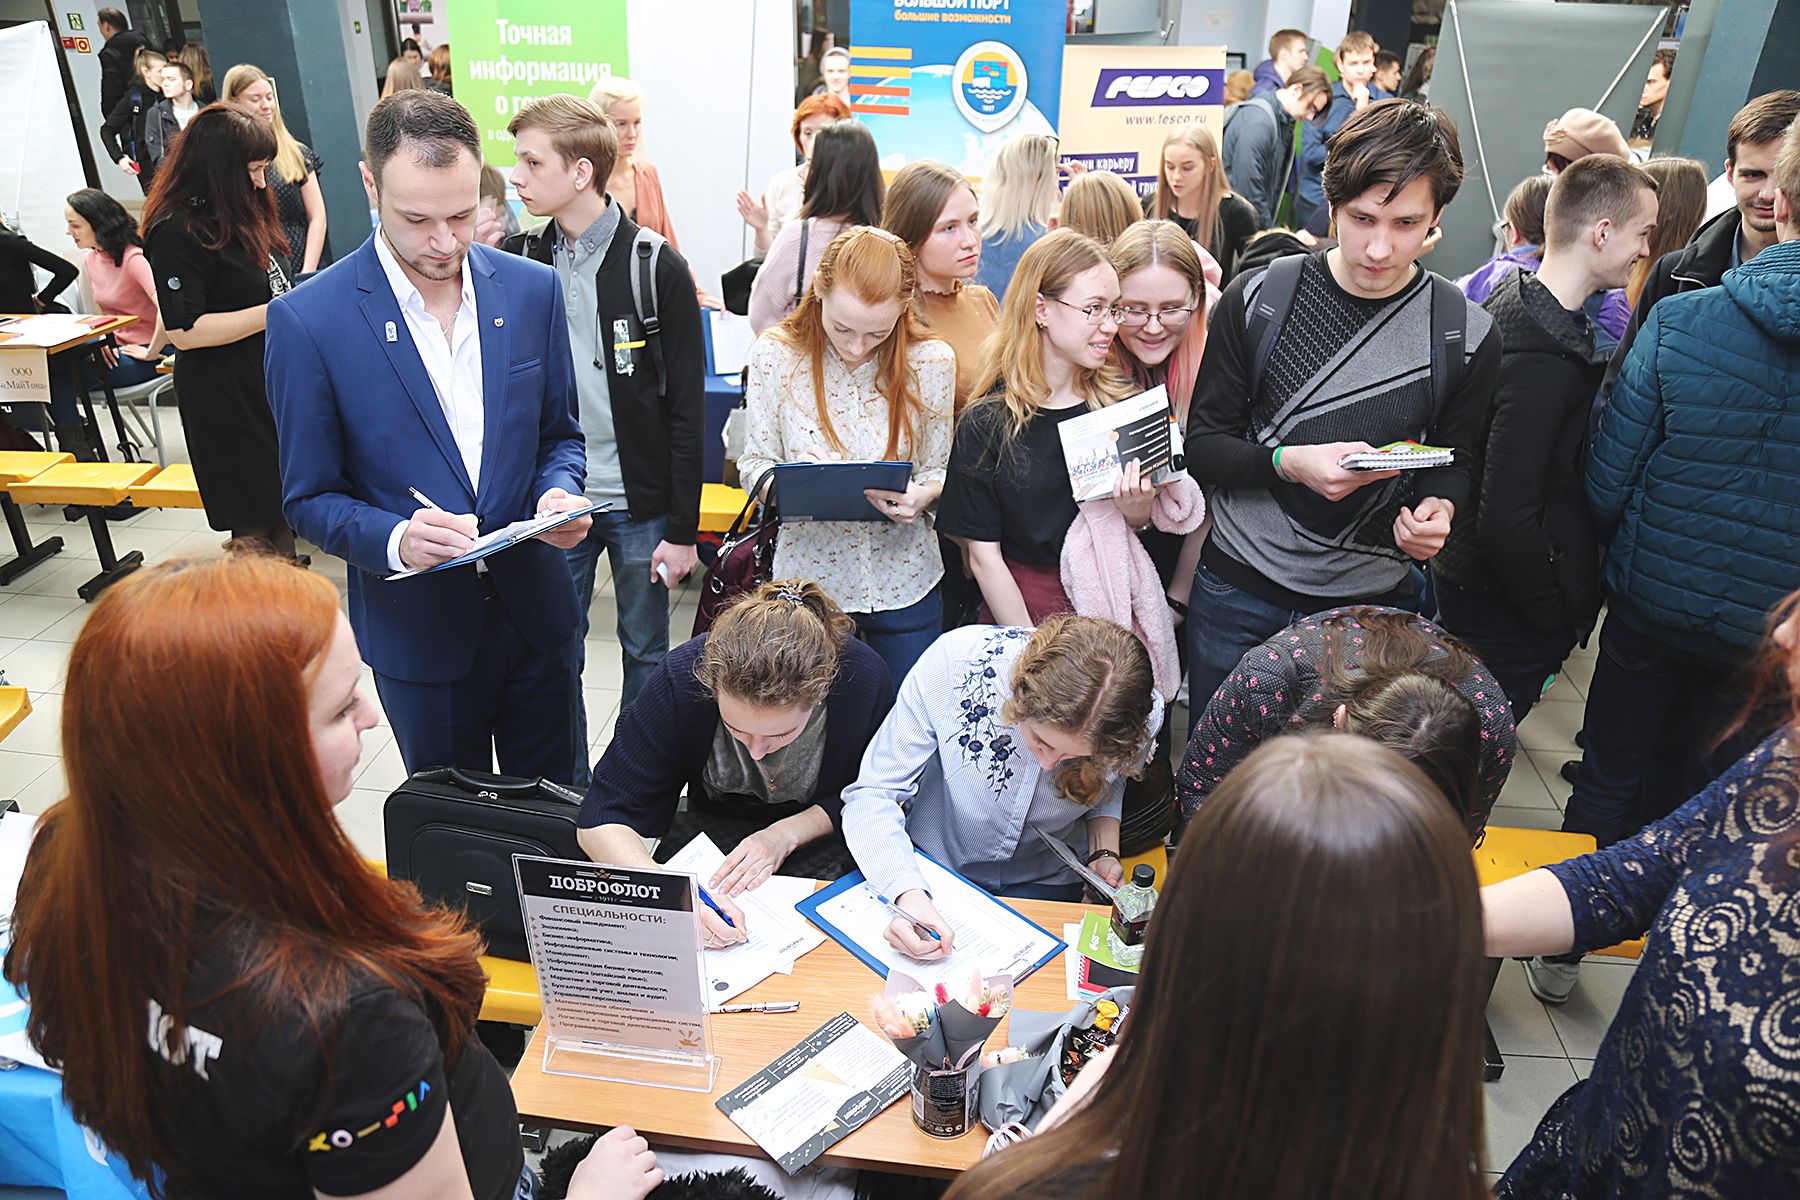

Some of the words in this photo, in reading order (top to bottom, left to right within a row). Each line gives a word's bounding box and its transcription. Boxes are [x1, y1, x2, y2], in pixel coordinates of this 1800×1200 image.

[894, 10, 940, 21] большие
[942, 13, 1011, 24] возможности
[496, 19, 572, 45] Точная
[470, 55, 612, 86] информация
[1105, 76, 1210, 98] FESCO
[1126, 114, 1207, 125] www.fesco.ru
[1097, 157, 1134, 172] карьеру
[11, 367, 33, 376] ООО
[549, 875, 661, 899] ДОБРОФЛОТ
[552, 904, 667, 924] СПЕЦИАЛЬНОСТИ:
